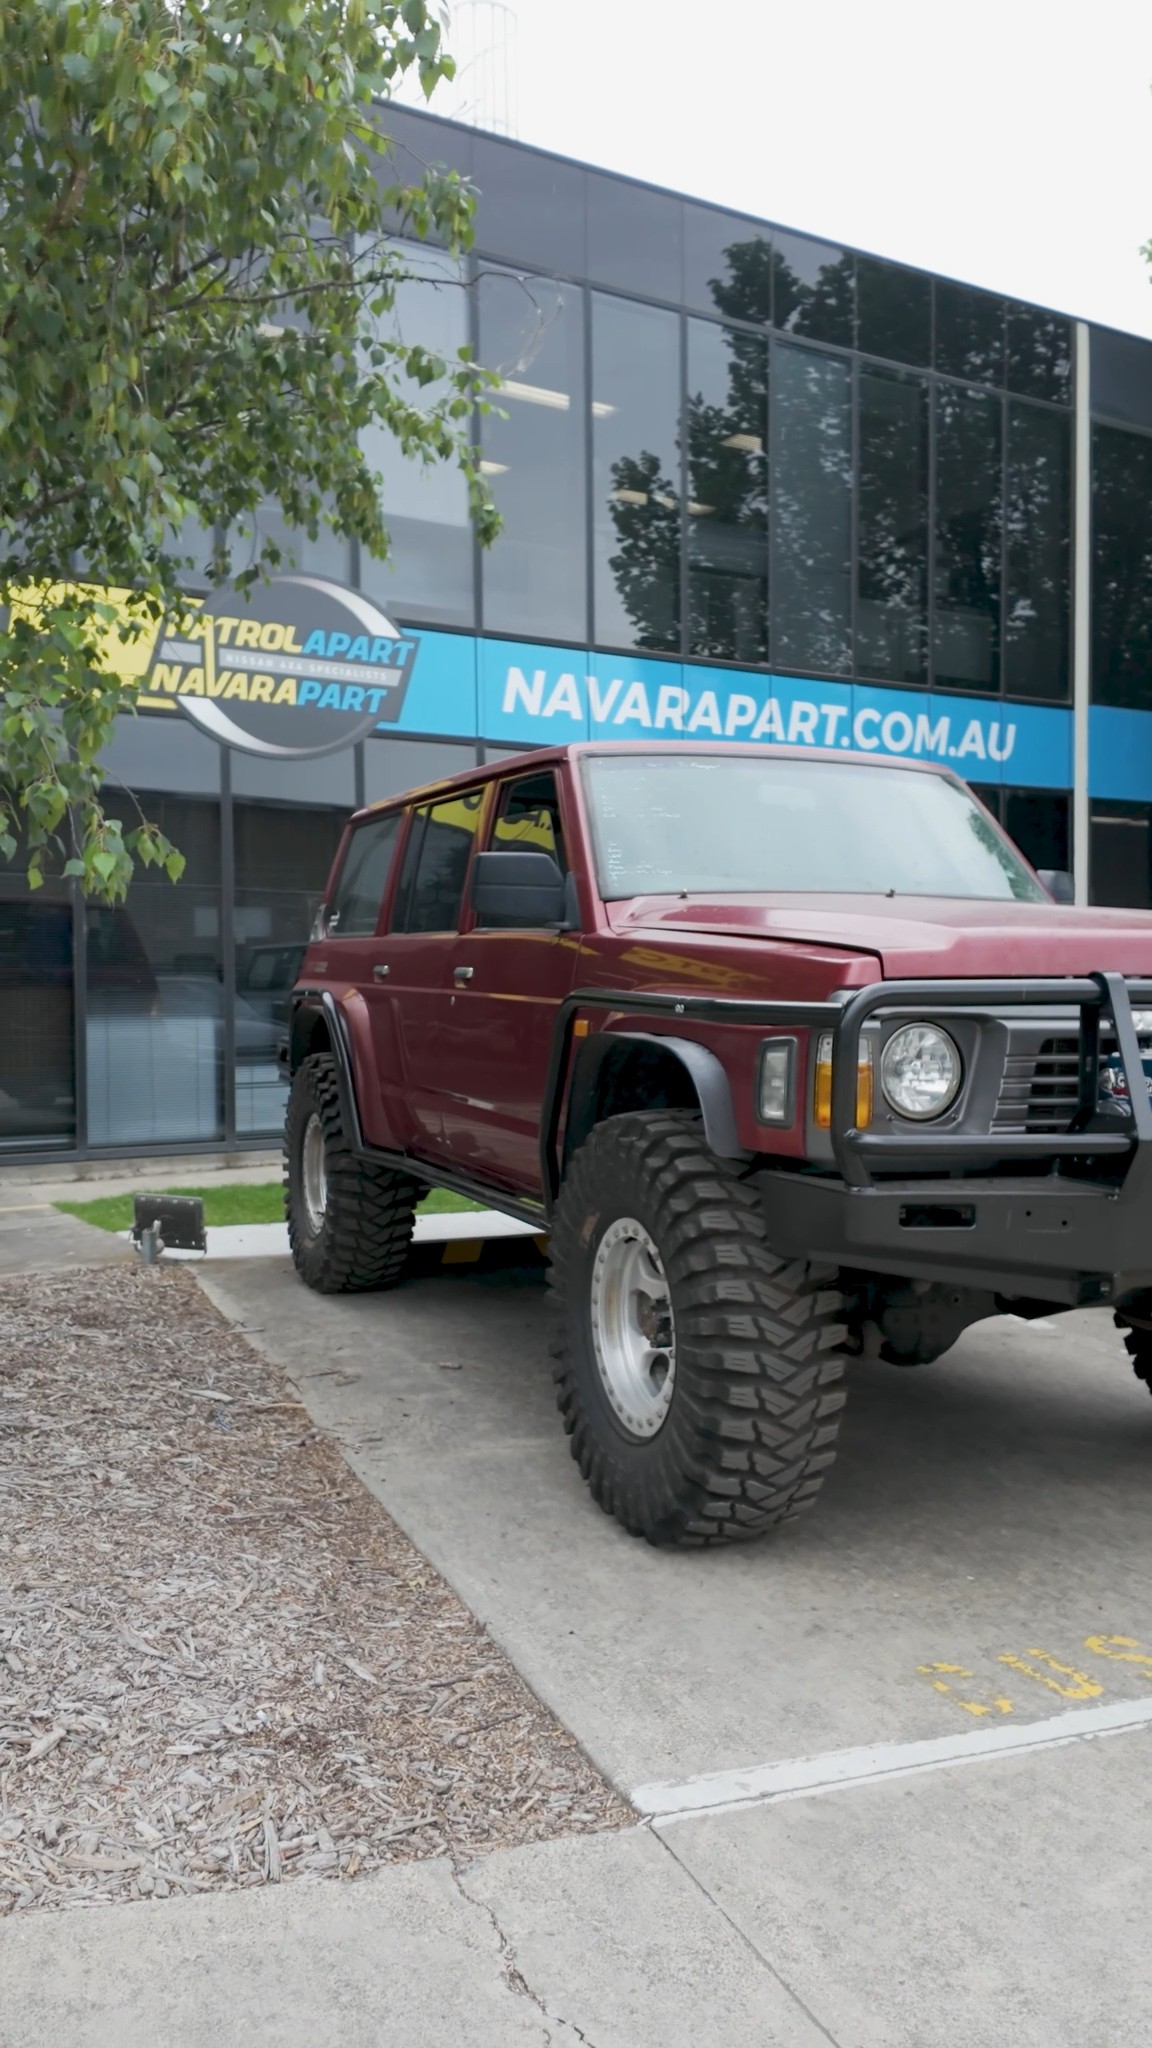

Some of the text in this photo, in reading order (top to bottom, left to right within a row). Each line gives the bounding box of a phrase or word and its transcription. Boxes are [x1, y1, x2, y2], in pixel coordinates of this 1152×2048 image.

[149, 663, 388, 713] NAVARAPART
[225, 653, 274, 668] NISSAN
[309, 663, 387, 681] SPECIALISTS
[502, 666, 1017, 762] NAVARAPART.COM.AU
